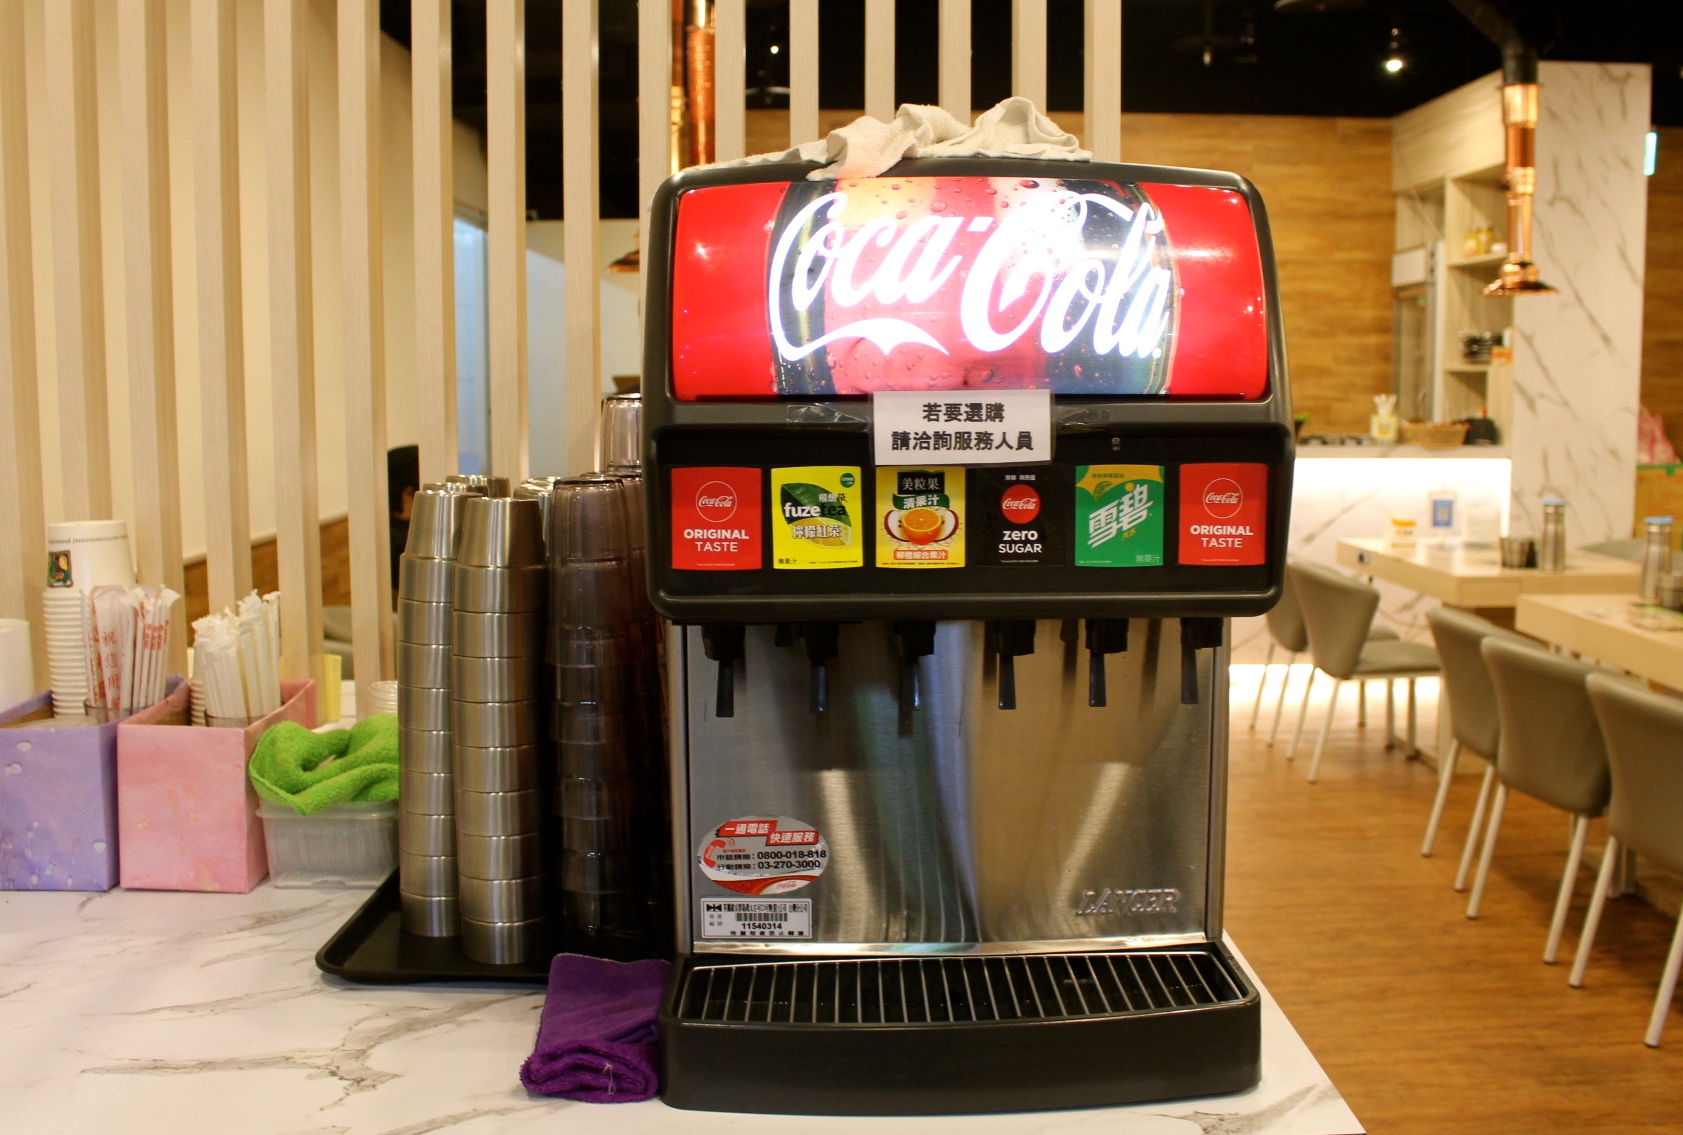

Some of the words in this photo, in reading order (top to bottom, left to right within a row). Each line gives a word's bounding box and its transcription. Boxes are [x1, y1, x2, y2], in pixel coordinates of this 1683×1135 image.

[768, 191, 1171, 361] Coca-Cola
[923, 403, 1005, 422] 若要選購
[891, 431, 1034, 451] 請洽詢服務人員
[901, 477, 940, 491] 美粒果
[698, 495, 734, 508] Coca-Cola
[1002, 497, 1038, 510] Coca-Cola
[1206, 492, 1240, 504] Coca-Cola
[1087, 483, 1154, 549] 雪碧
[683, 528, 750, 540] ORIGINAL
[793, 525, 841, 539] 檸檬紅茶
[1002, 530, 1039, 541] zero
[1189, 525, 1254, 536] ORIGINAL
[695, 541, 739, 552] TASTE
[998, 543, 1043, 554] SUGAR
[1201, 537, 1243, 548] TASTE
[725, 823, 770, 835] 一通電話
[769, 832, 815, 843] 快速服務
[757, 850, 827, 860] 0800-018-818
[757, 860, 821, 870] 03-270-3000
[741, 922, 782, 930] 11540314
